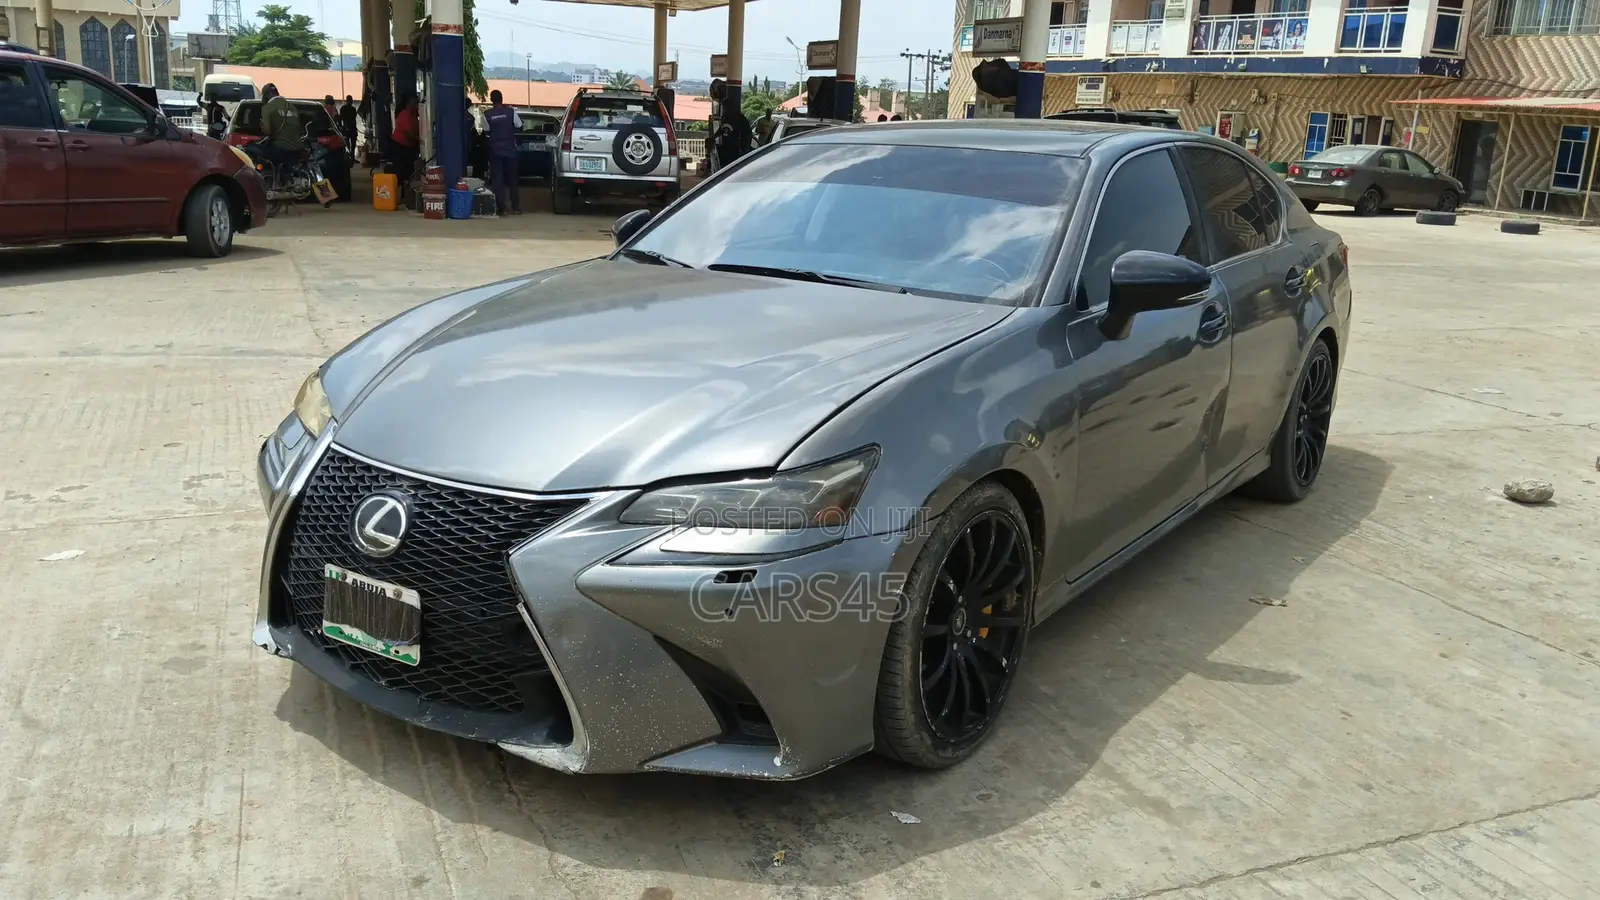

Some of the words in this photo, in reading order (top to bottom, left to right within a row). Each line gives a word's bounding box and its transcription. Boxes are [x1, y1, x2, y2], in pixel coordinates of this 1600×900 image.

[983, 27, 1012, 40] Danmarna
[426, 202, 444, 211] FIRE
[351, 578, 388, 597] ABUJA
